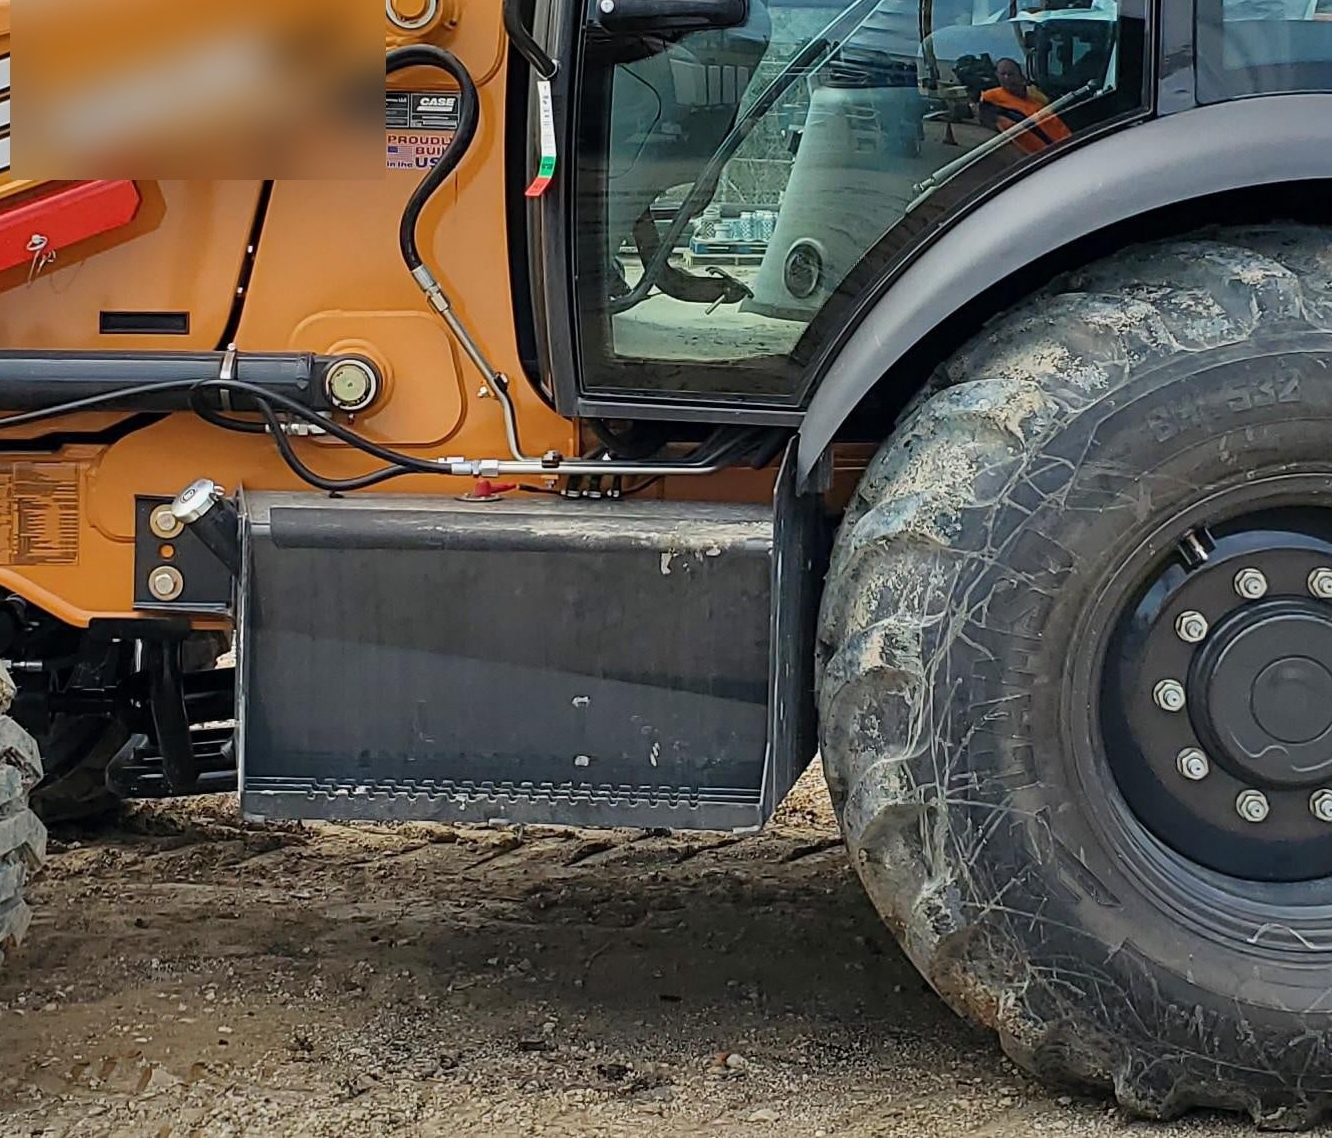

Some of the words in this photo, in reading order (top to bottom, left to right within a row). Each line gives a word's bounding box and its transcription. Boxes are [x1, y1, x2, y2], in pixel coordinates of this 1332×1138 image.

[419, 97, 456, 107] CASE
[415, 157, 440, 168] US
[1225, 368, 1301, 413] 532
